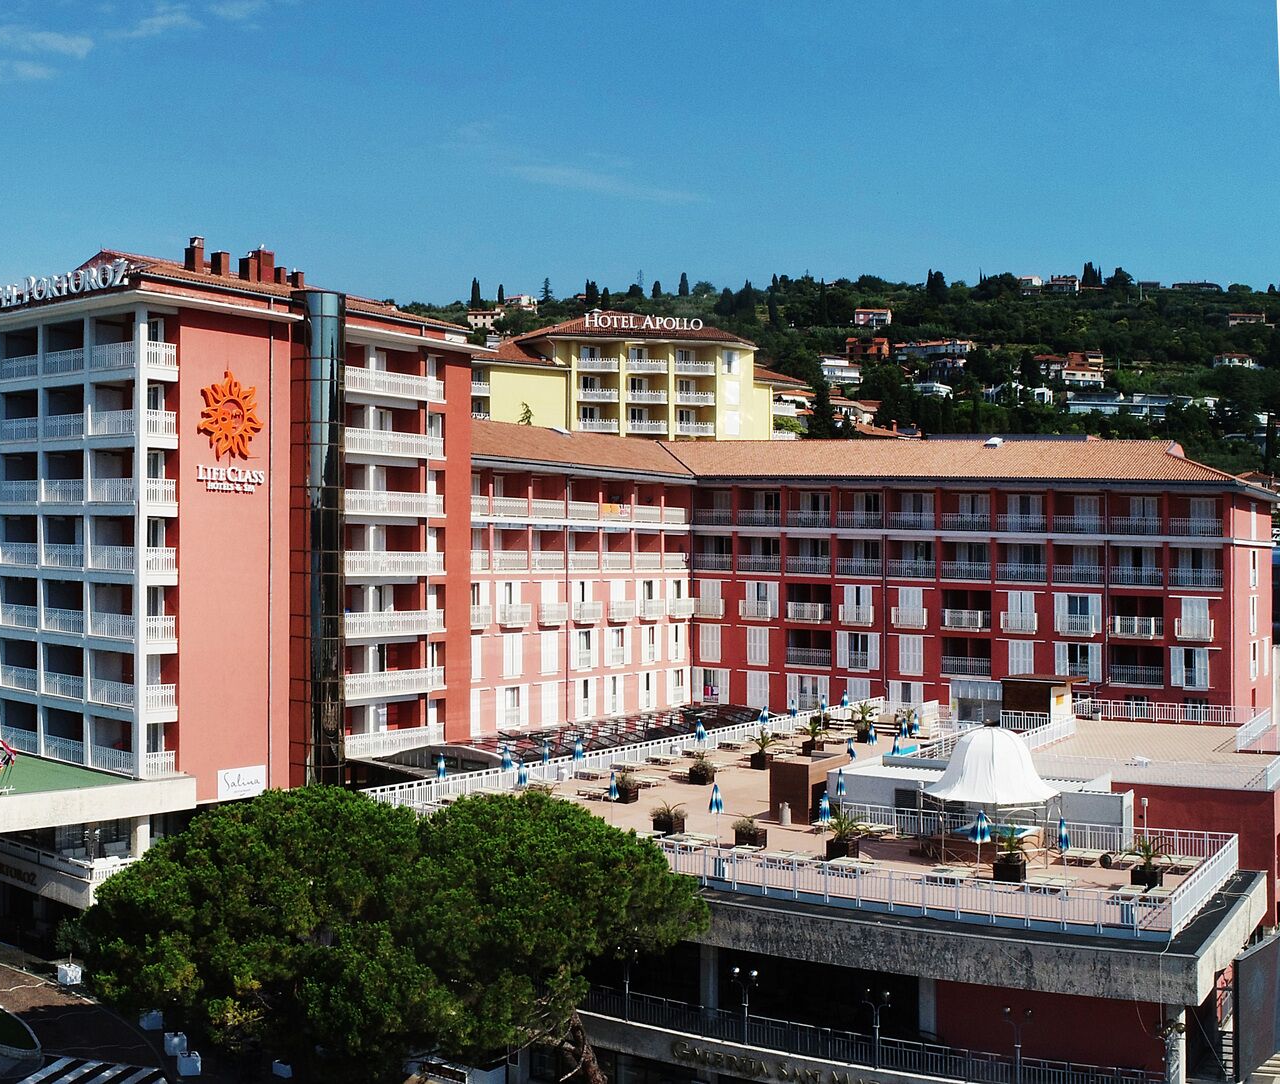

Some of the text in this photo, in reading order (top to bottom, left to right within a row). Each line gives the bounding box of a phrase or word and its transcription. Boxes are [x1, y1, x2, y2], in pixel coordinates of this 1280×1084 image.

[584, 313, 703, 330] HOTEL APOLLO
[223, 772, 261, 791] Salina
